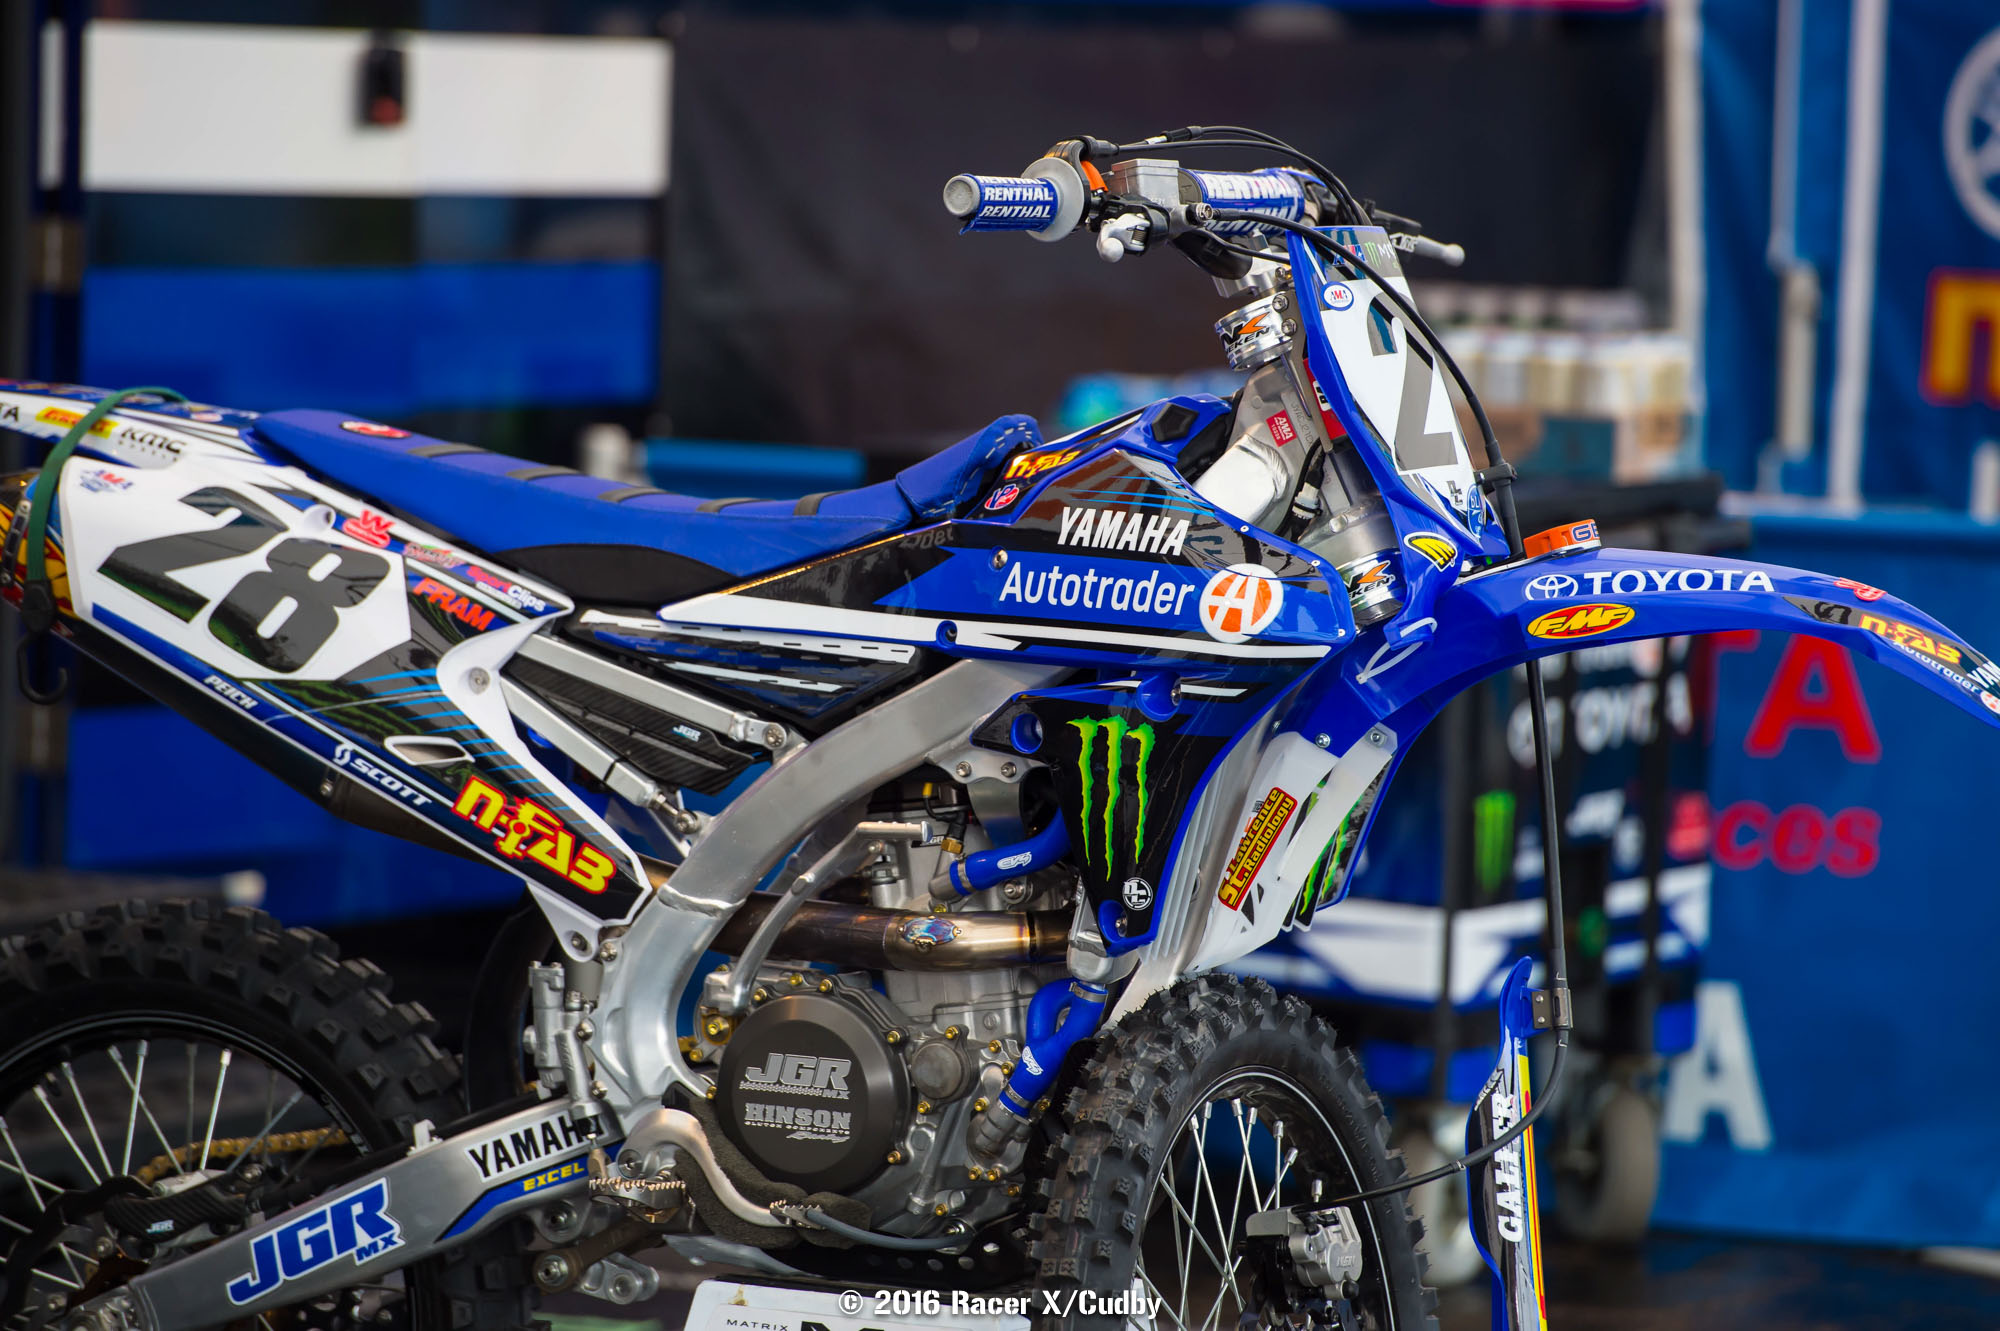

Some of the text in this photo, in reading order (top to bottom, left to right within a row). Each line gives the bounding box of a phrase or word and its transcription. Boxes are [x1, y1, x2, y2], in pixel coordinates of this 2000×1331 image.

[984, 187, 1053, 201] RENTHAL
[978, 206, 1051, 218] RENTHAL
[1226, 326, 1271, 354] EKEN
[120, 427, 188, 455] KMC
[1277, 416, 1294, 441] AMA
[1057, 506, 1191, 557] YAMAHA
[96, 486, 391, 674] 28
[1000, 562, 1195, 616] Autotrader
[1348, 573, 1395, 599] KEN
[1583, 570, 1775, 594] TOYOTA
[412, 577, 496, 632] FRAM
[1531, 605, 1632, 638] FMF
[1893, 638, 1980, 693] Autotrader
[350, 758, 433, 807] SCOTT
[1228, 788, 1280, 874] Lawrence
[1243, 796, 1295, 873] Radiology
[745, 1052, 851, 1090] JGR
[822, 1089, 851, 1100] MX
[744, 1102, 851, 1130] HINSON
[522, 1162, 585, 1192] EXCEL
[229, 1181, 400, 1303] JGR
[355, 1231, 404, 1264] MX
[726, 1319, 789, 1331] MATRIX
